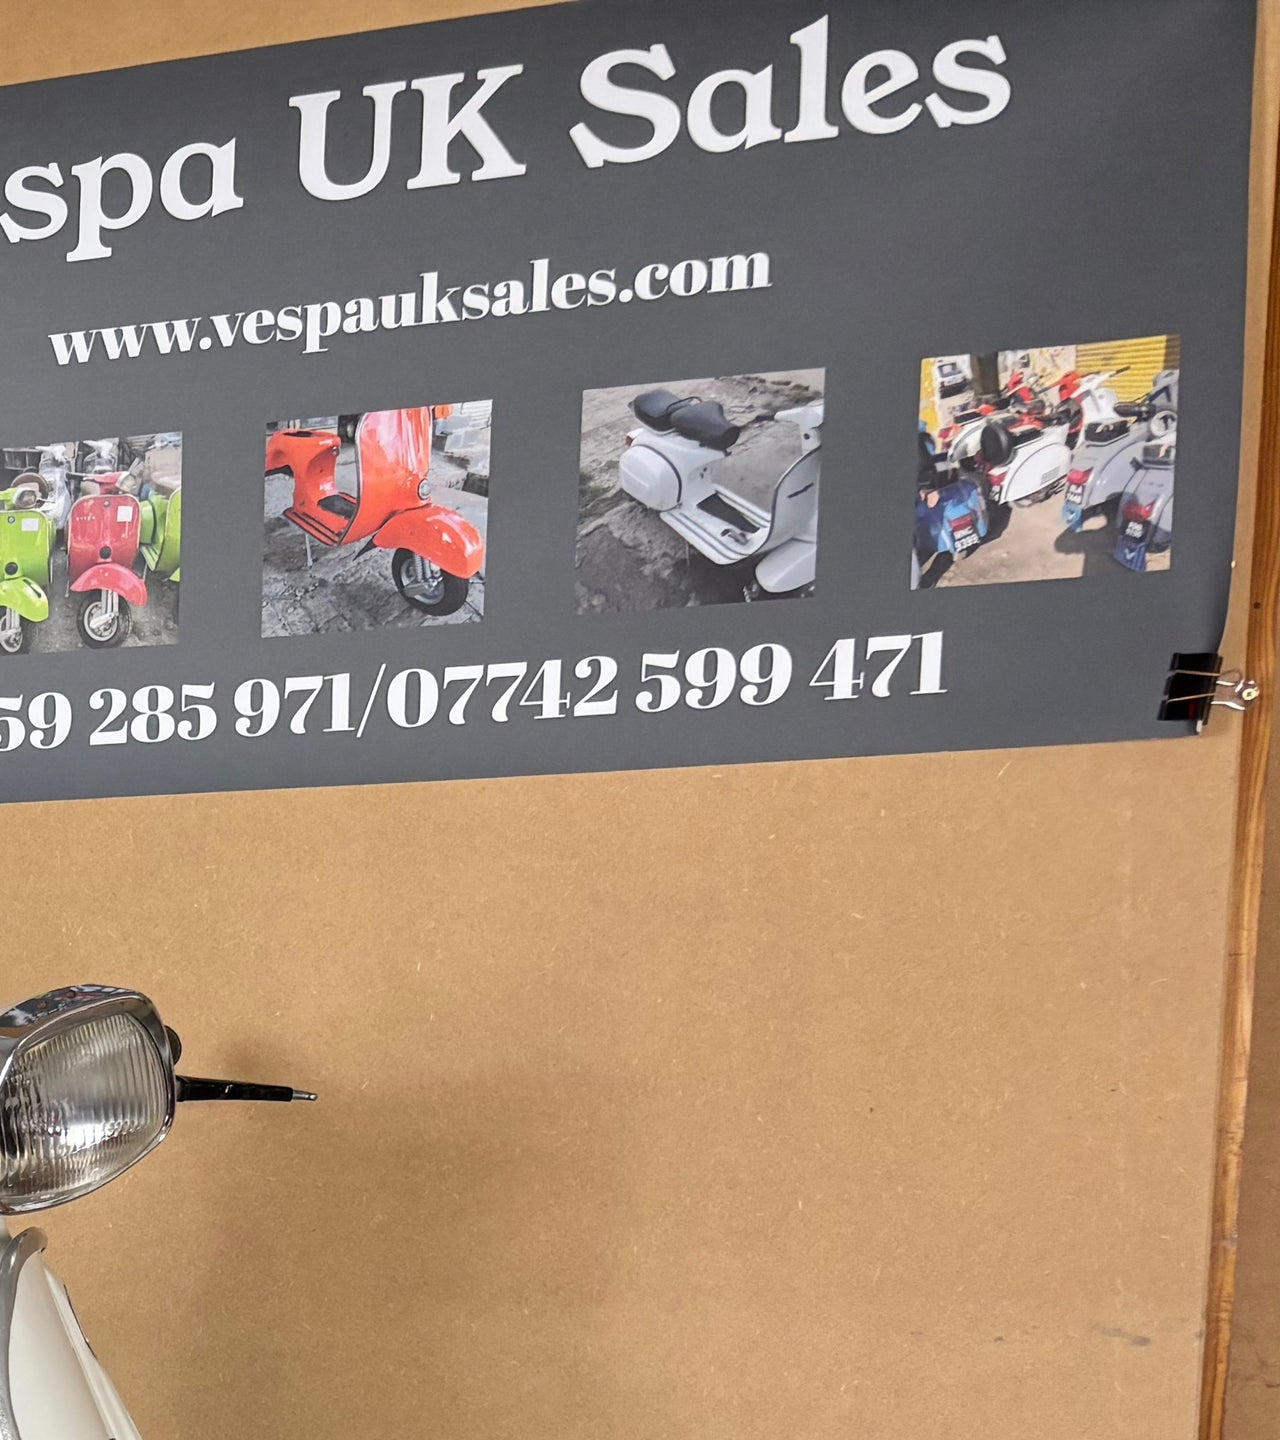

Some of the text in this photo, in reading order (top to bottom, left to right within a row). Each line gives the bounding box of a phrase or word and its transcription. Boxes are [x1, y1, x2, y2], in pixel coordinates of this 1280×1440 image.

[289, 64, 526, 200] UK
[570, 15, 1010, 167] Sales
[48, 253, 772, 365] www.vespauksales.com
[90, 682, 217, 745] 285
[234, 656, 618, 737] 971/07742
[636, 644, 792, 712] 599
[809, 631, 947, 700] 471
